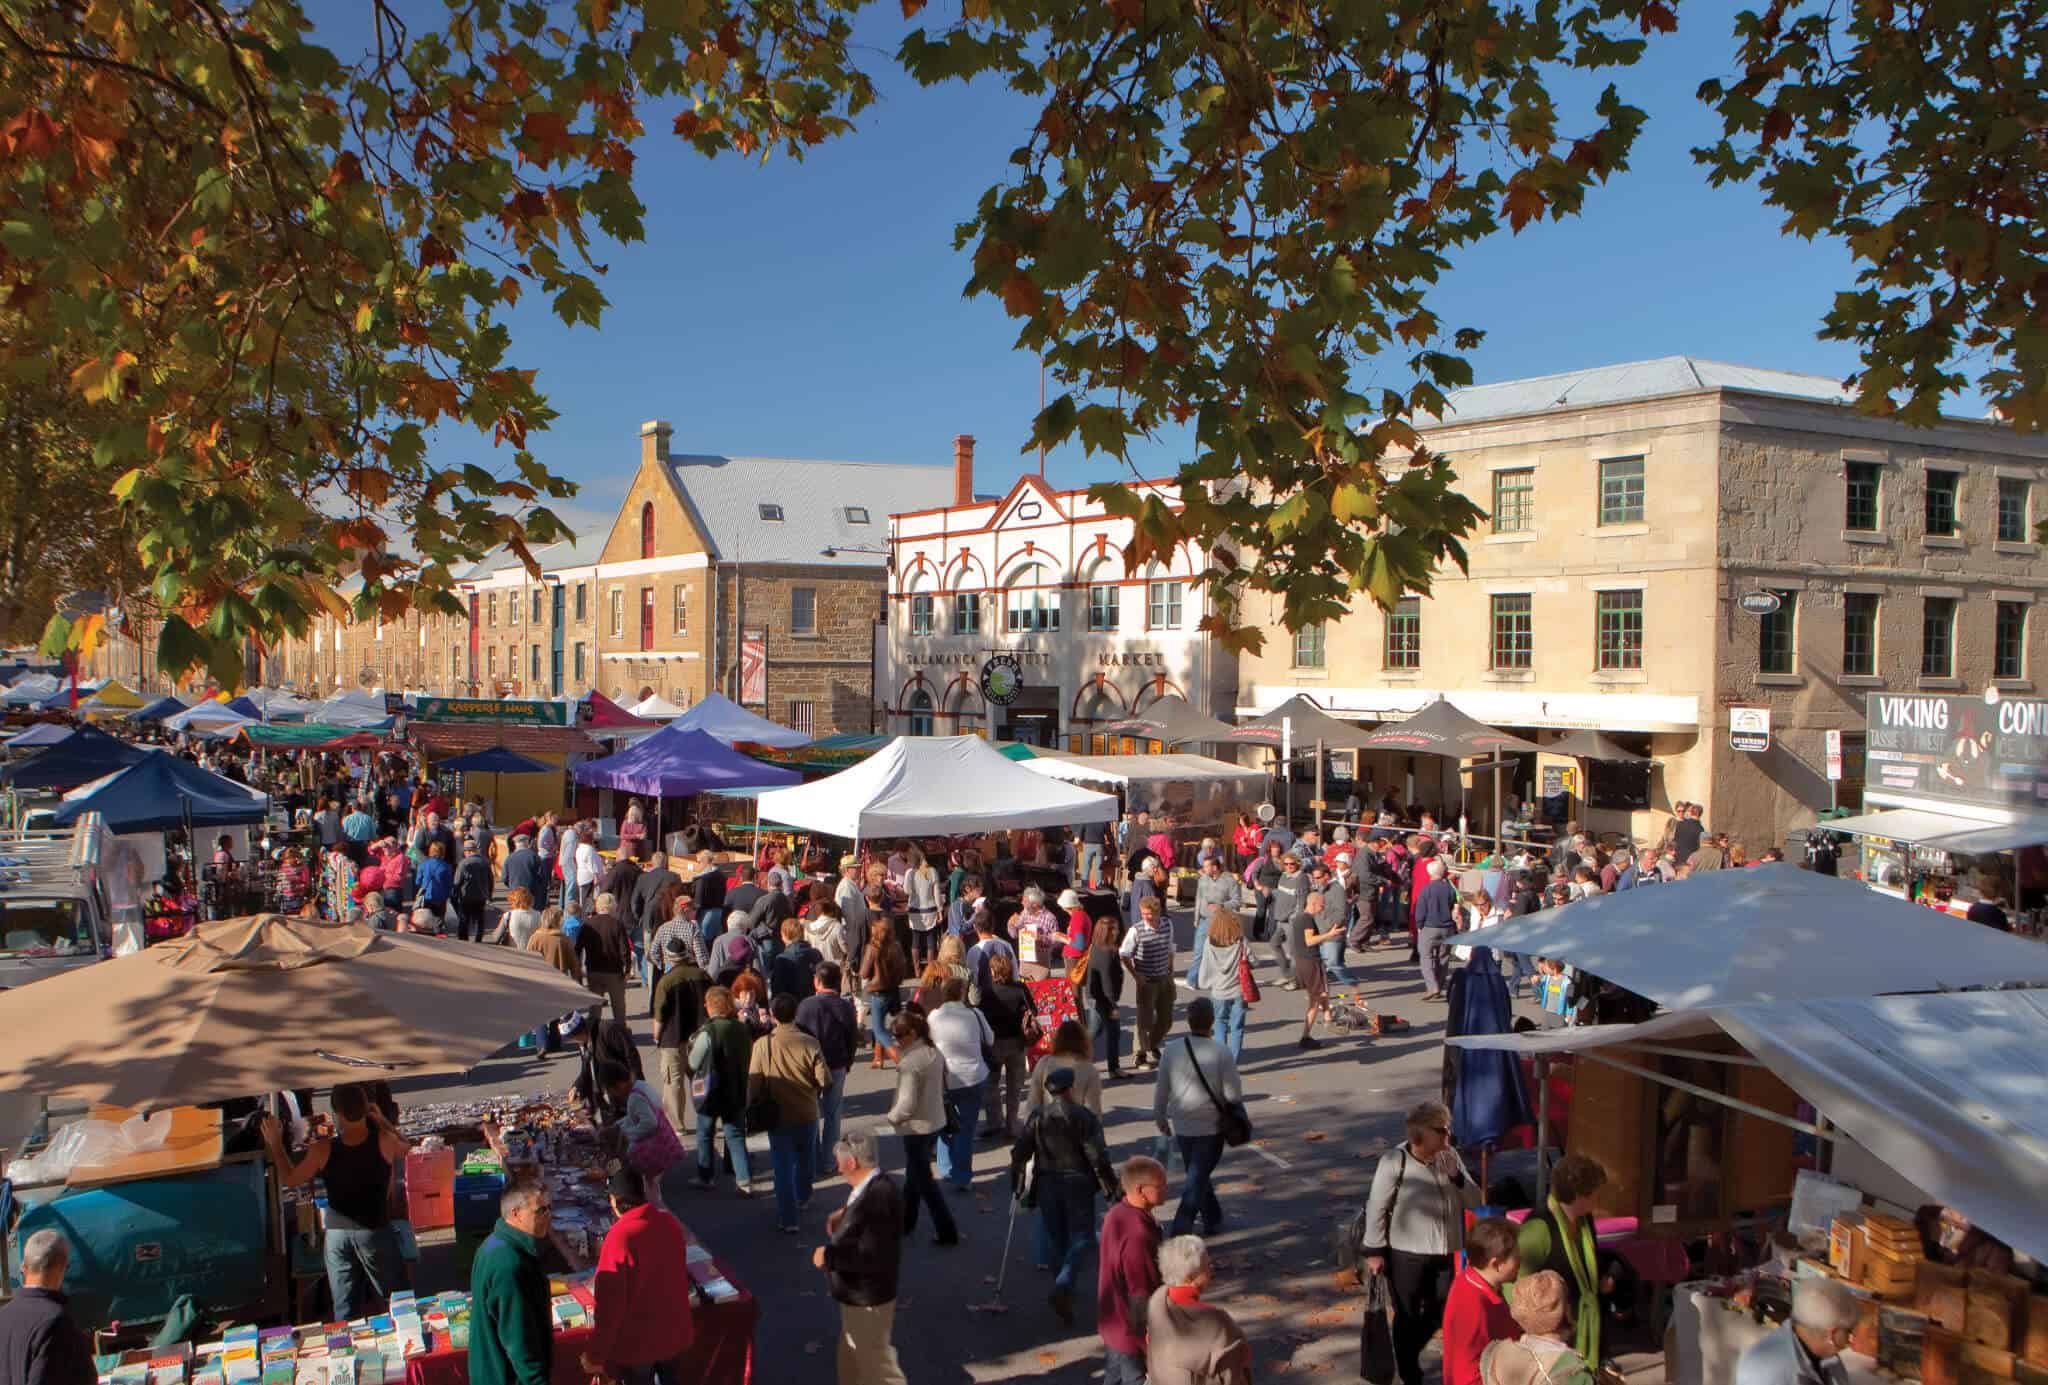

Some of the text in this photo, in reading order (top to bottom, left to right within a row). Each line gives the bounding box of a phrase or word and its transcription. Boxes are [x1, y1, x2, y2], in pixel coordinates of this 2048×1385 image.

[907, 653, 1164, 666] SALAMANCA RUIT MARKET
[1879, 697, 1949, 729] VIKING
